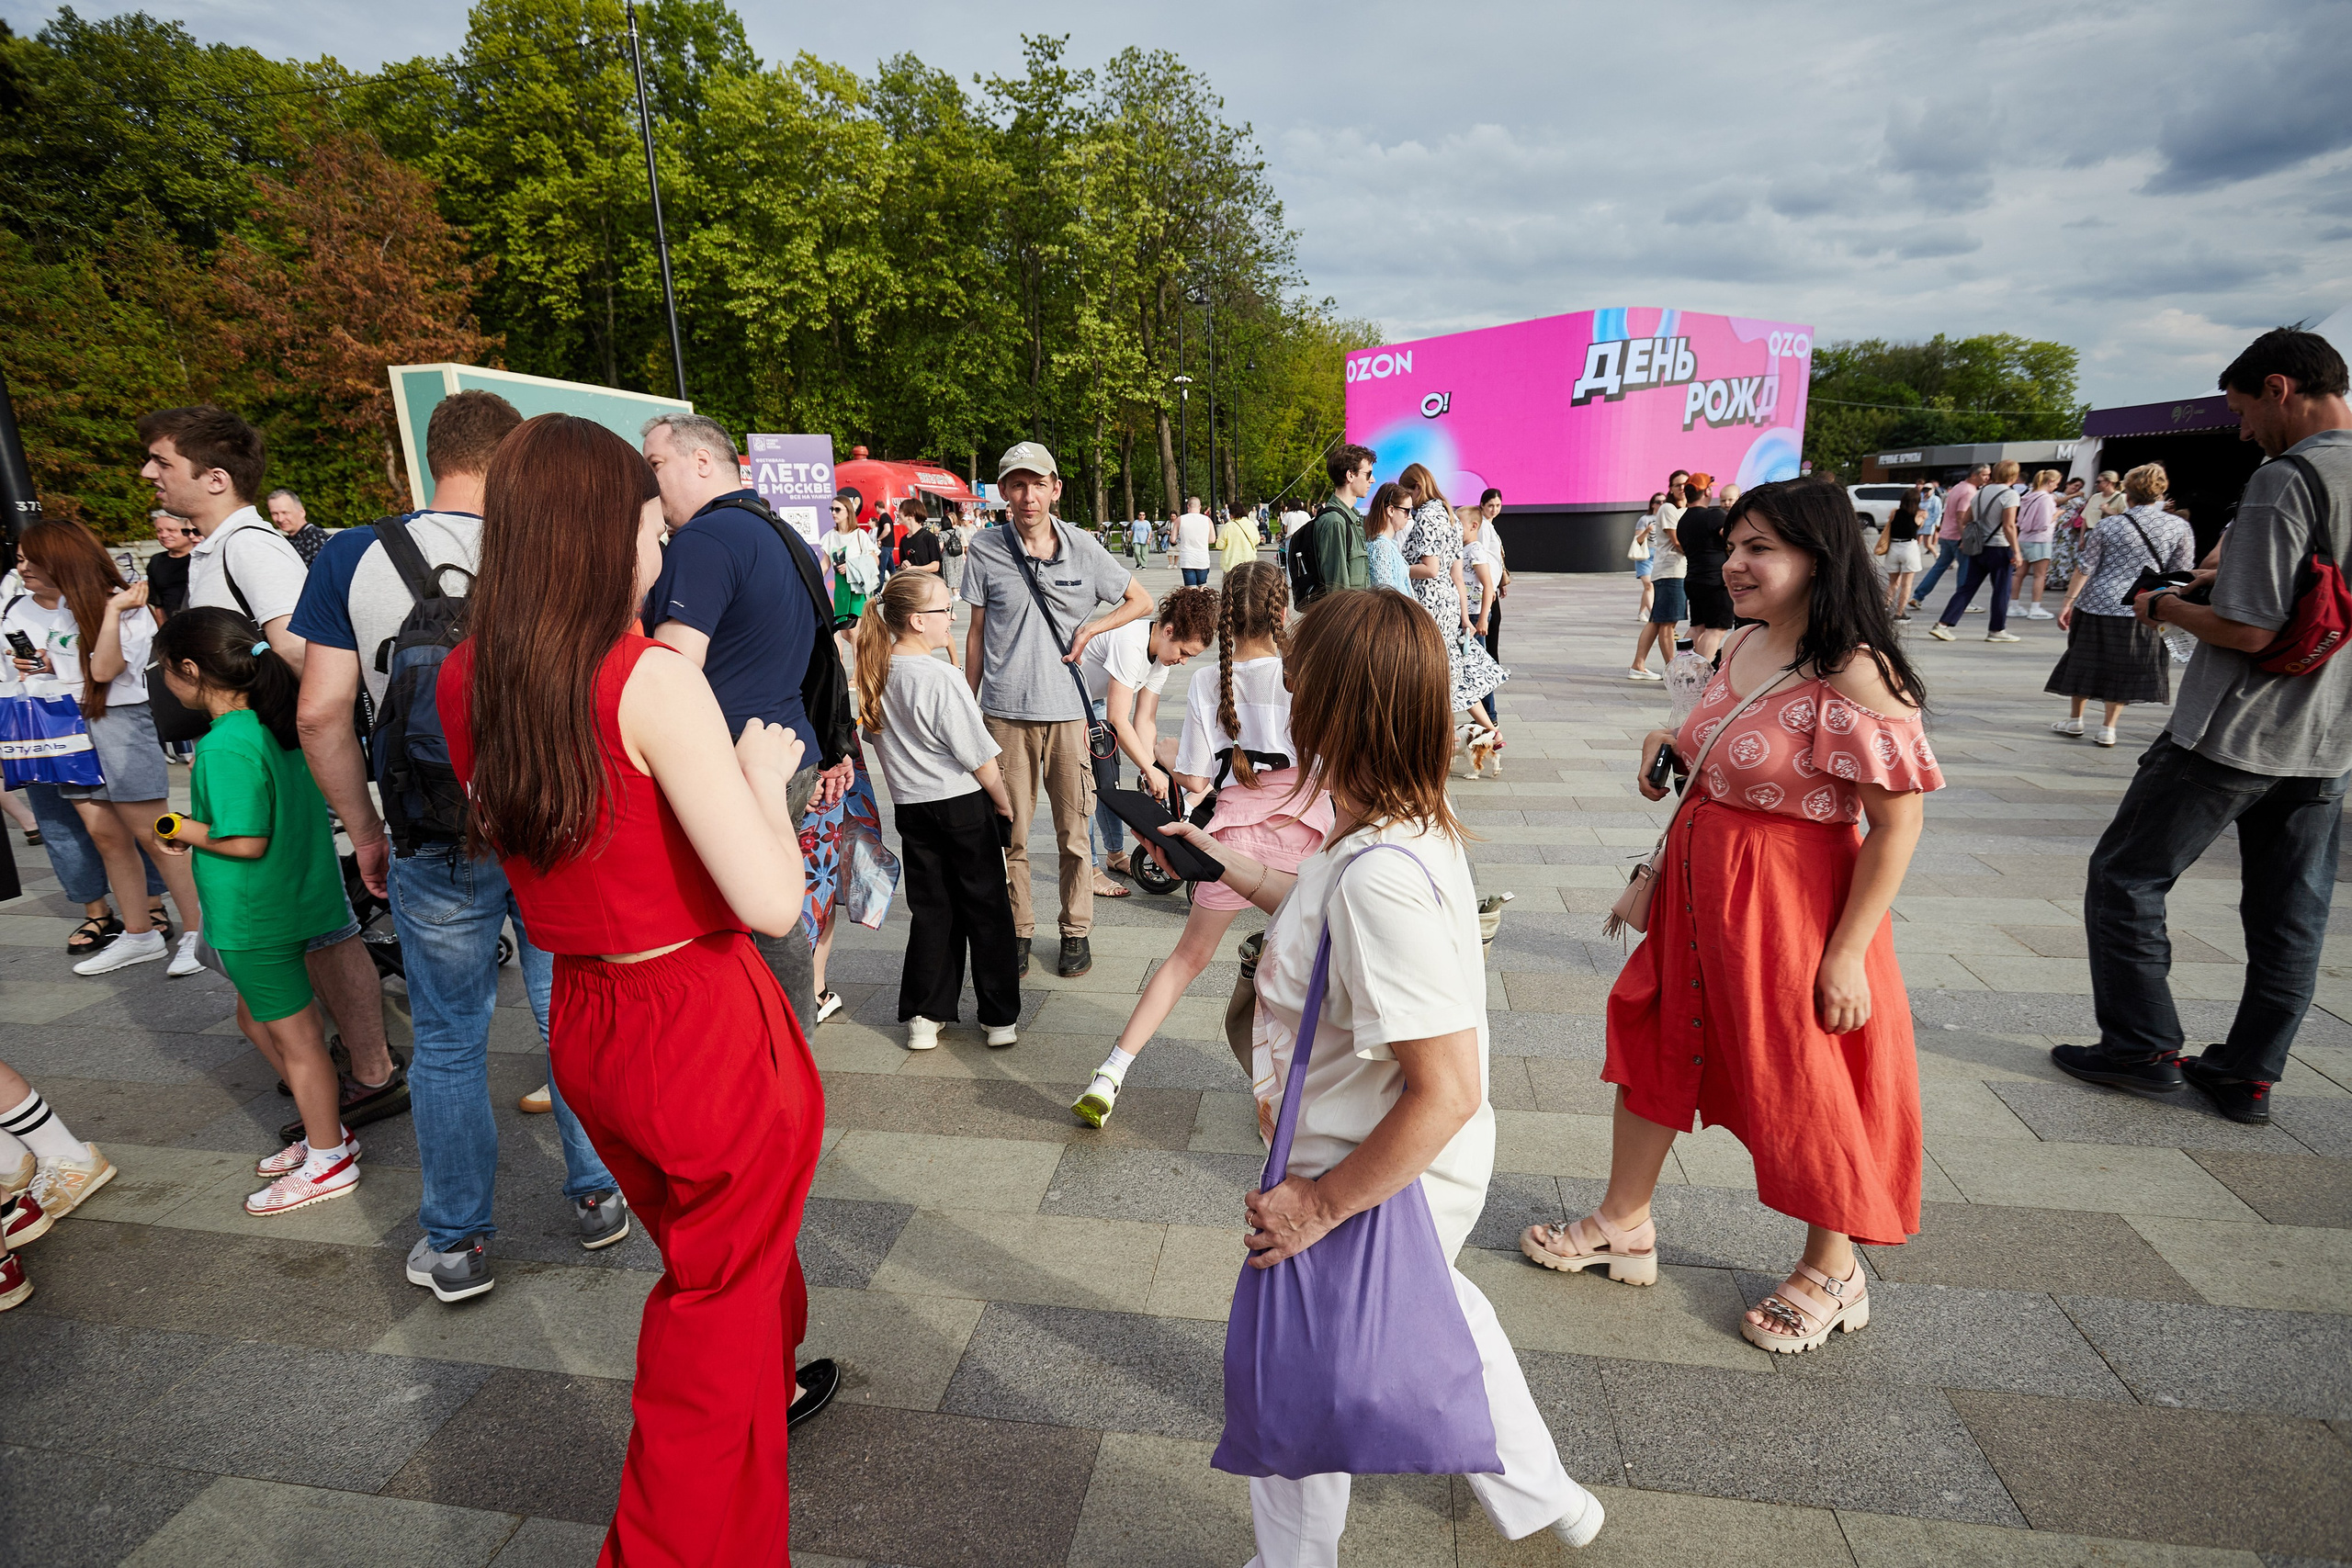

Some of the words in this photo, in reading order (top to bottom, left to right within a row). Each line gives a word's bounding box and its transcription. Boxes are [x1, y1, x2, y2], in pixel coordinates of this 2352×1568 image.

[1346, 350, 1412, 383] OZON
[1571, 337, 1696, 406] ДЕНЬ
[1683, 375, 1779, 432] РОЖД
[758, 462, 831, 483] ЛЕТО
[758, 483, 769, 494] В
[771, 482, 831, 494] МОСКВЕ
[2300, 630, 2341, 665] ОЛИМП
